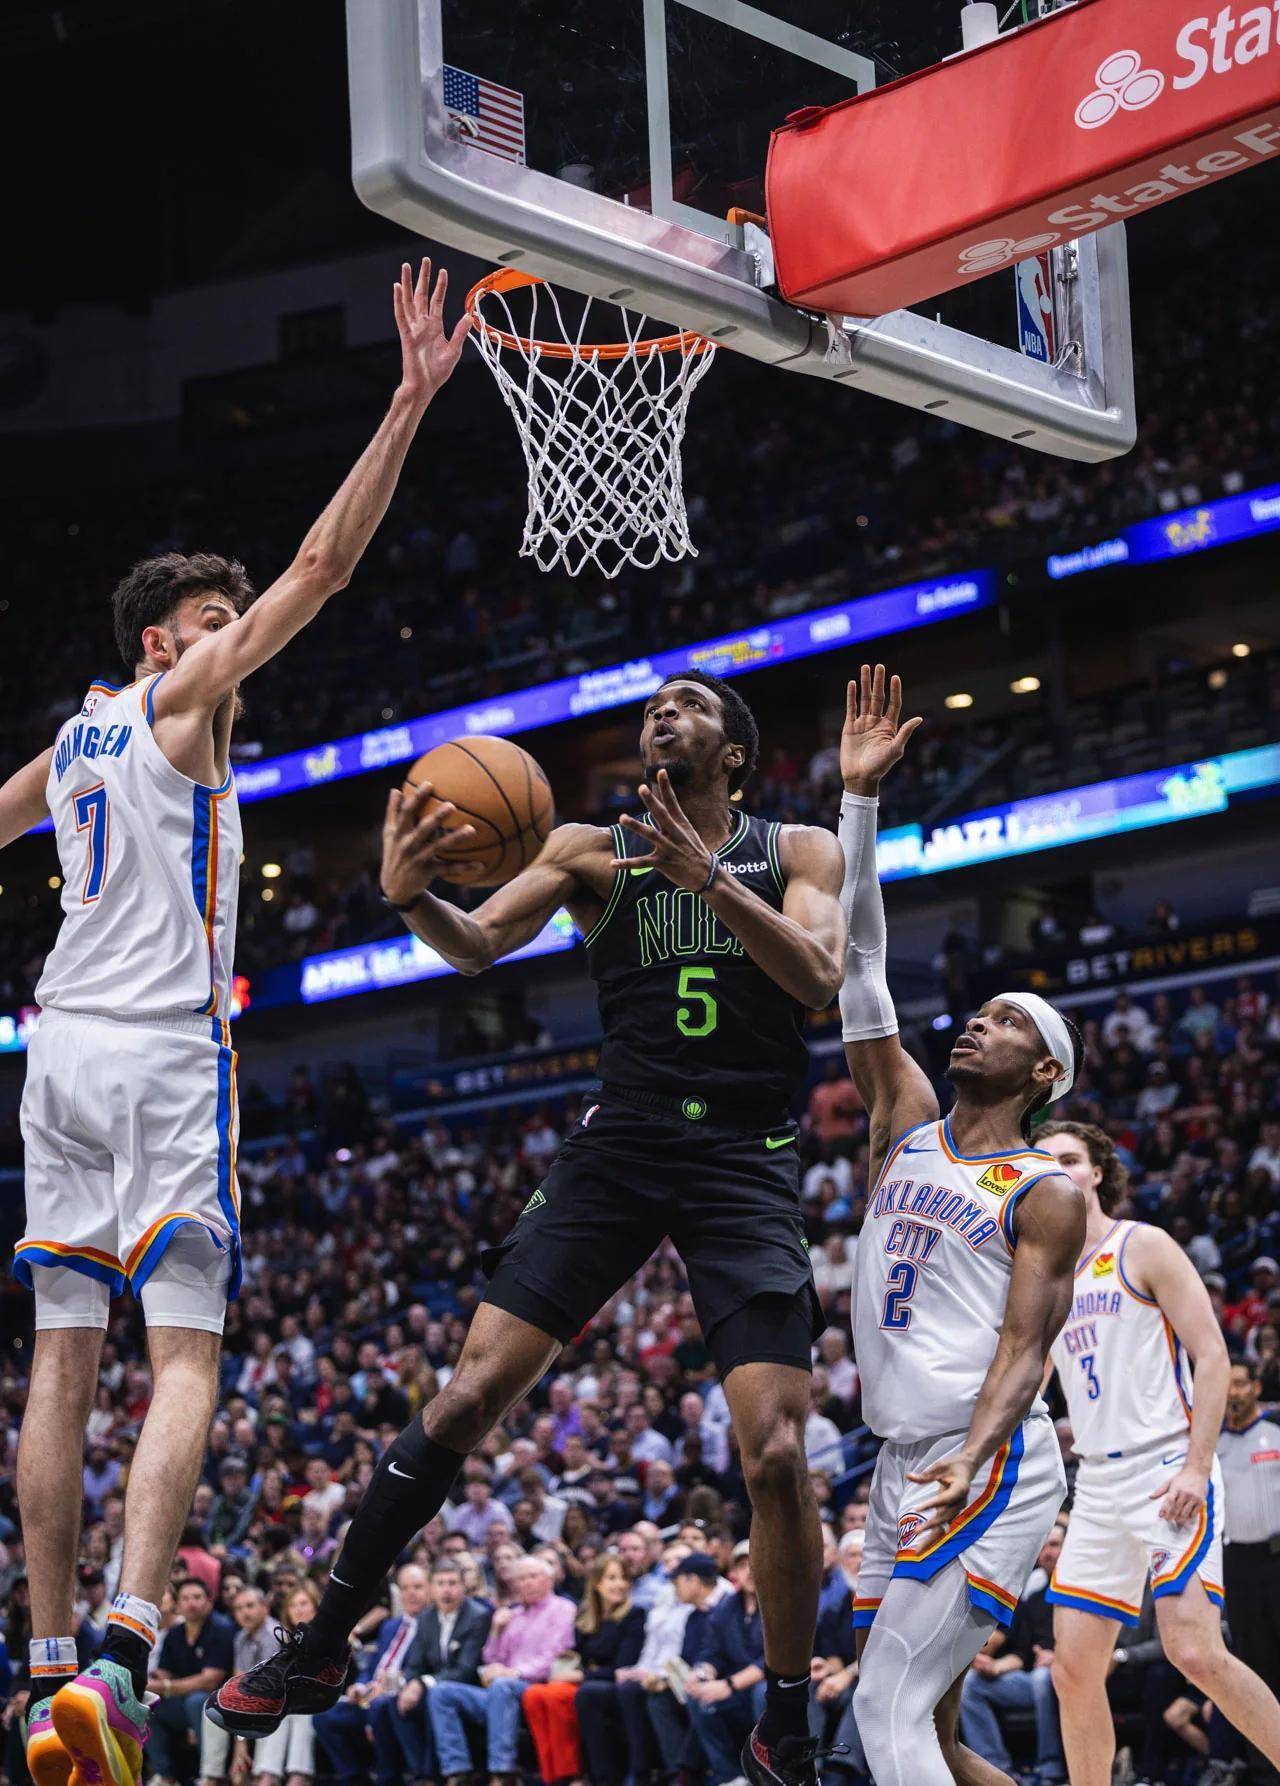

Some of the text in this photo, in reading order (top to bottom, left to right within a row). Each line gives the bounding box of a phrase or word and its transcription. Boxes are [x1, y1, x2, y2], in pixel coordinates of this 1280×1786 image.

[1172, 0, 1280, 90] Sta
[1047, 150, 1249, 231] State
[1024, 330, 1043, 356] NBA
[55, 723, 132, 783] HOLMGEN
[72, 781, 110, 905] 7
[723, 861, 768, 874] ibotta
[637, 887, 744, 967] NOL
[676, 966, 718, 1037] 5
[873, 1180, 1000, 1253] OKLAHOMA
[884, 1219, 942, 1264] CITY
[879, 1259, 919, 1332] 2
[1063, 1322, 1099, 1355] CITY
[1080, 1354, 1101, 1400] 3
